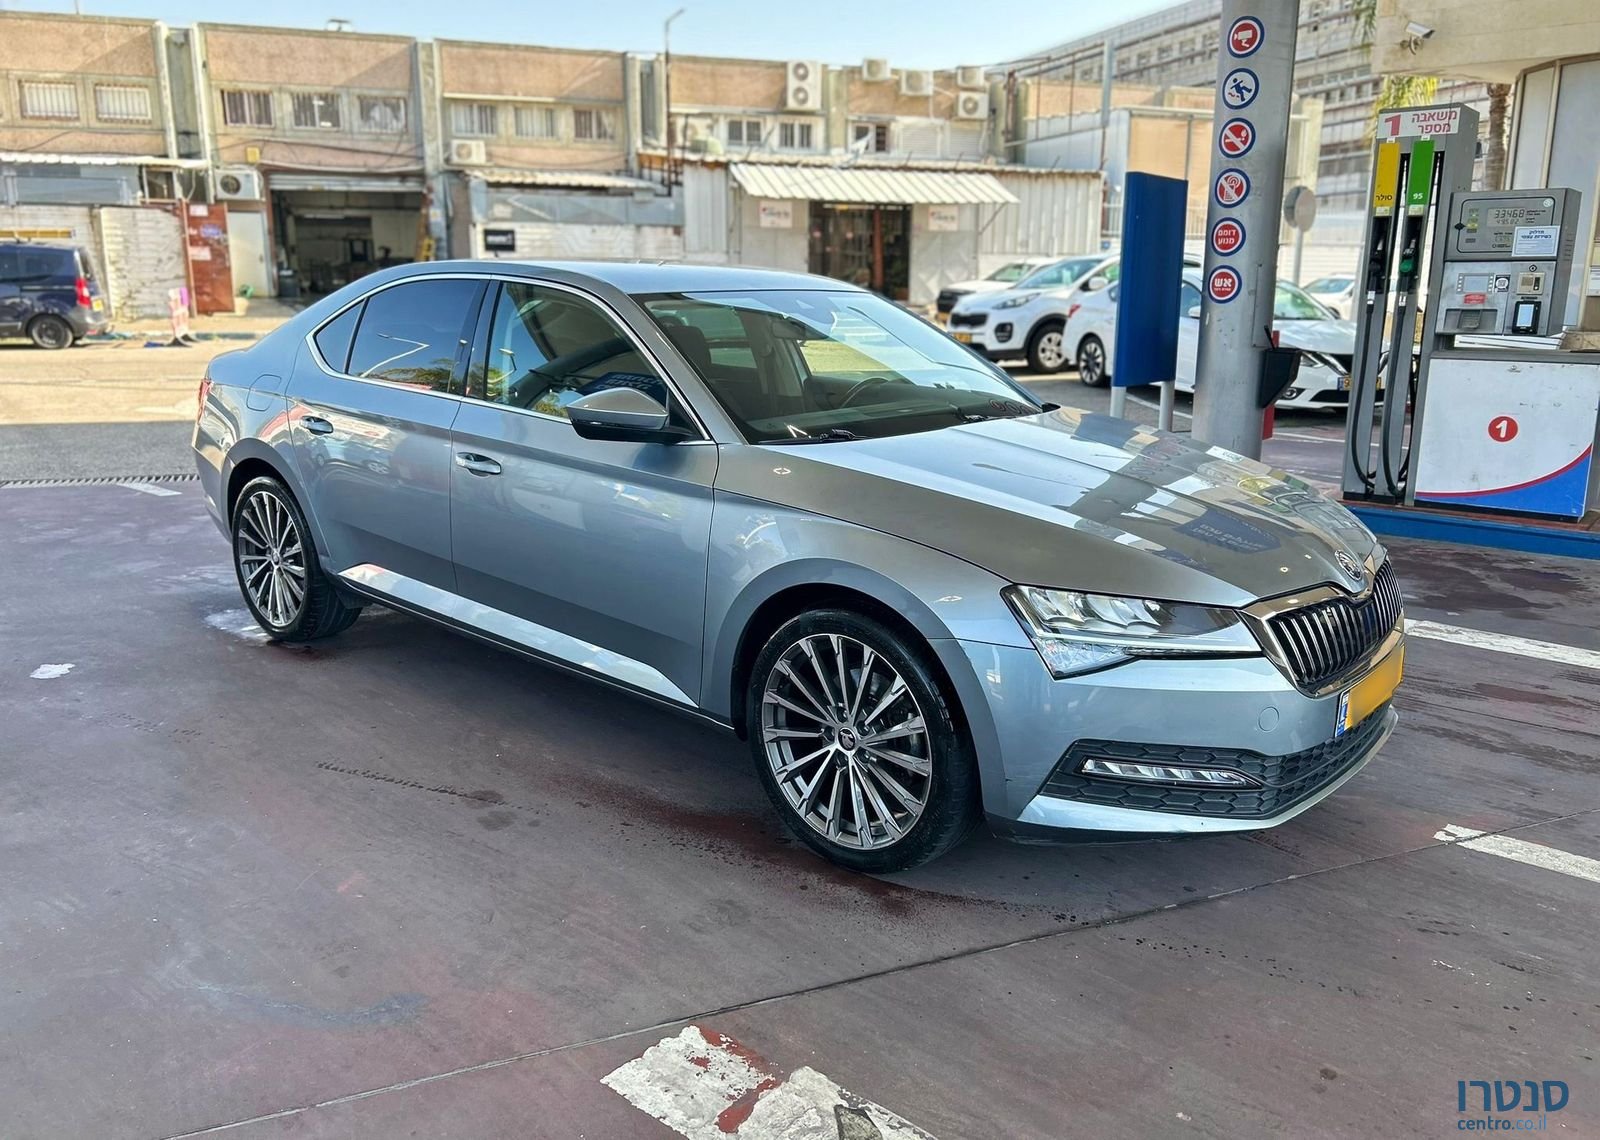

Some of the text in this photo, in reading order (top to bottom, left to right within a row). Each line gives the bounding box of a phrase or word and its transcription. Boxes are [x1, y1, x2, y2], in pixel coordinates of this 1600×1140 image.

[1411, 110, 1457, 123] משאבה
[1384, 114, 1401, 136] 1
[1417, 123, 1451, 134] מספר
[1375, 193, 1393, 201] סולר
[1412, 192, 1424, 200] 95
[1218, 229, 1236, 237] דומם
[1214, 278, 1233, 287] אש
[1496, 420, 1508, 438] 1
